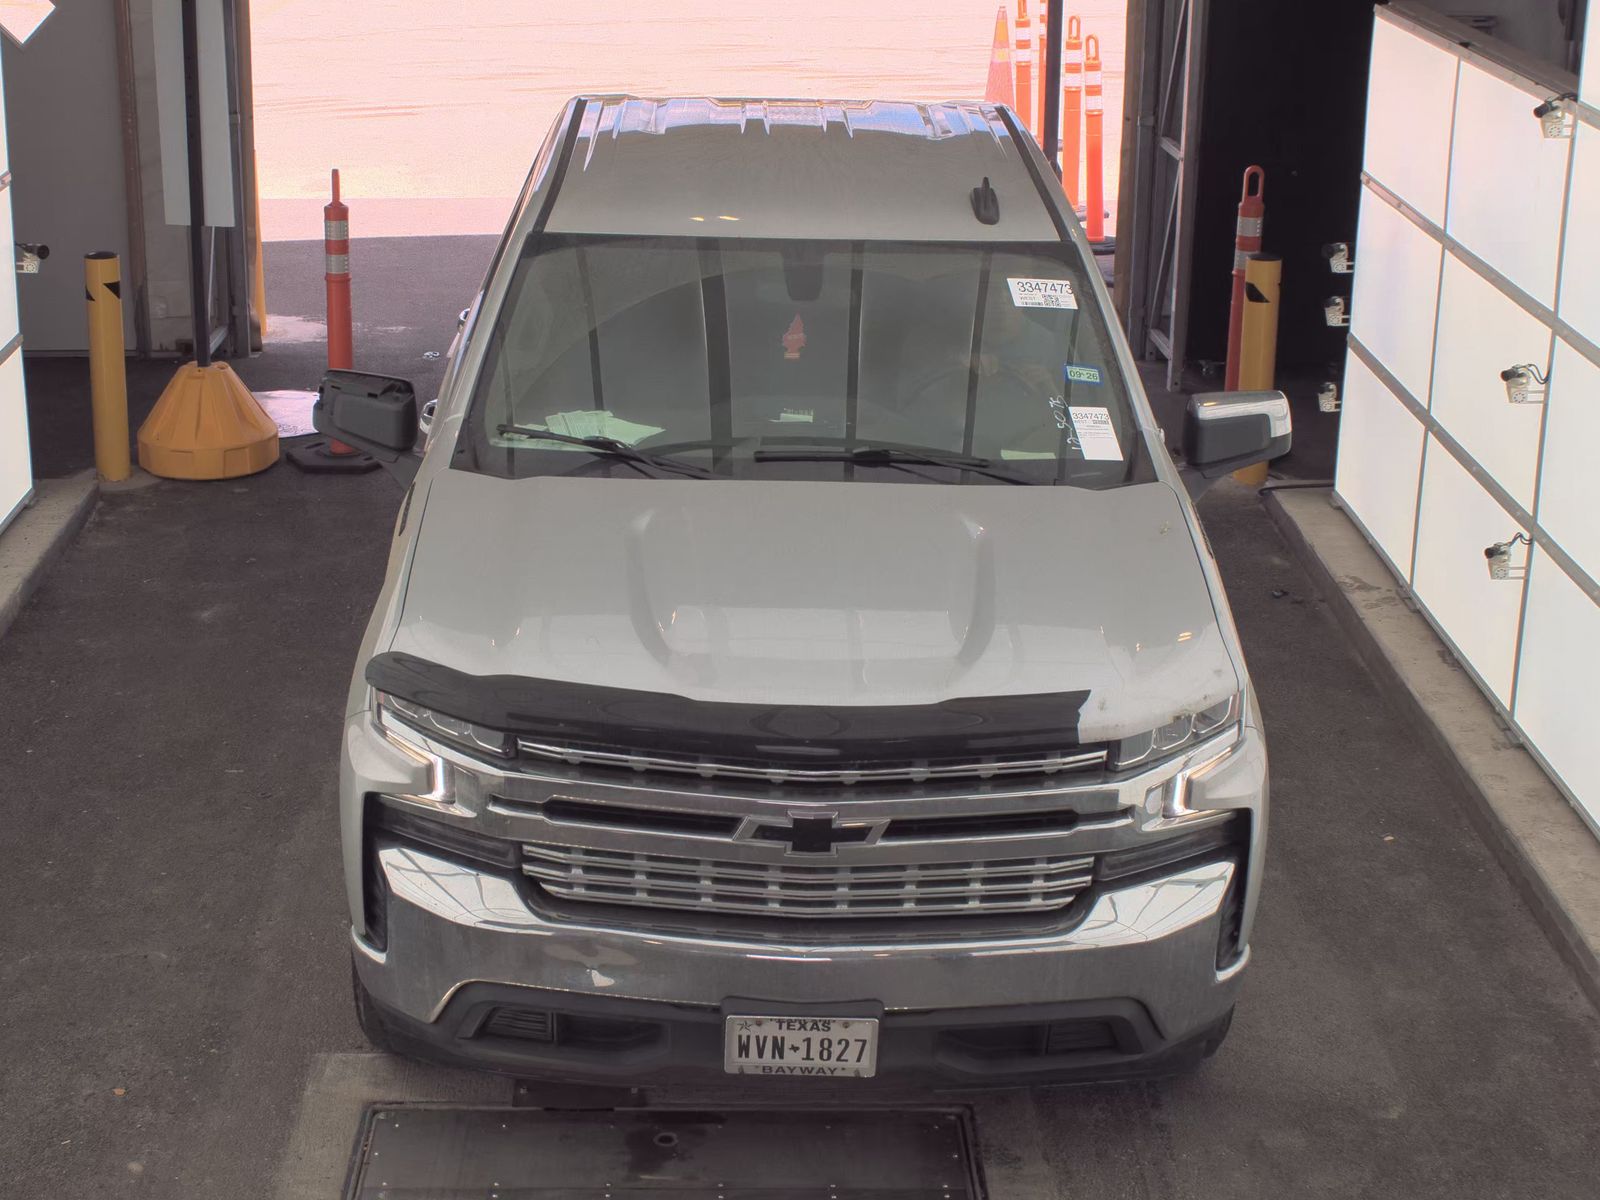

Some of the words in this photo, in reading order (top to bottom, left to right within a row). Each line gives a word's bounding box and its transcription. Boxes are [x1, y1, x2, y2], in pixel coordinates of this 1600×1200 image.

[1017, 281, 1073, 294] 3347473
[1086, 372, 1098, 381] 26
[1072, 412, 1110, 420] 3347473
[775, 1020, 831, 1032] TEXAS
[737, 1034, 785, 1060] WVN
[801, 1037, 868, 1063] 1827
[761, 1065, 838, 1075] BAYWAY
